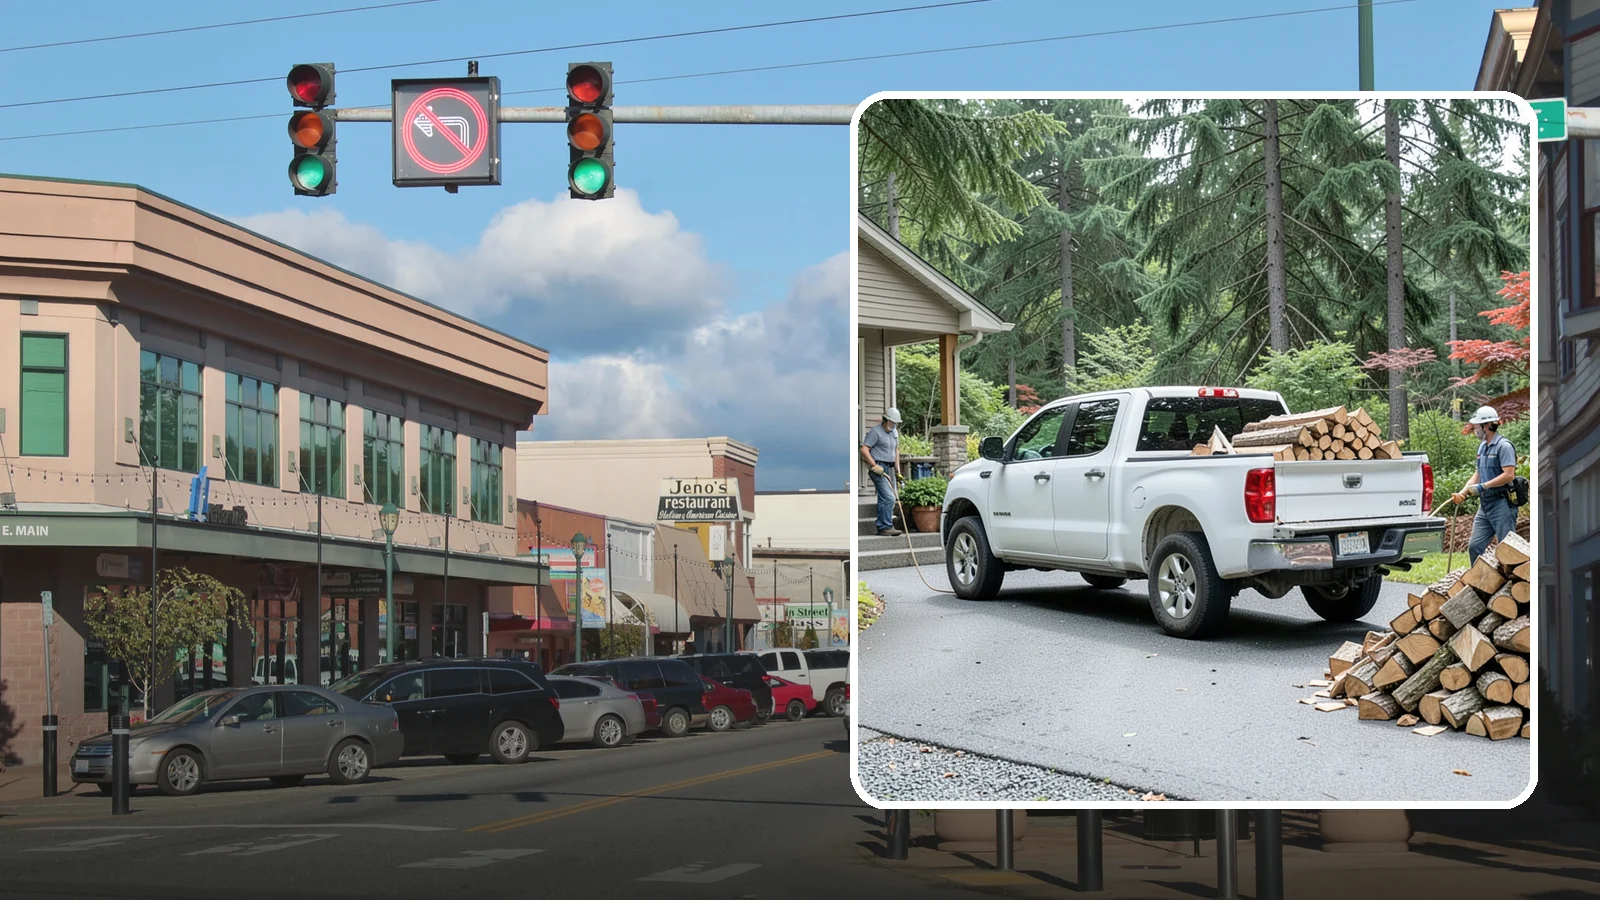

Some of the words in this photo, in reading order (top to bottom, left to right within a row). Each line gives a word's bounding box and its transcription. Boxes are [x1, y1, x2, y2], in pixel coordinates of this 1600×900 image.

[670, 480, 727, 494] Jeno's
[665, 496, 731, 509] restaurant
[658, 510, 681, 519] Italian
[686, 510, 715, 519] American
[715, 510, 737, 519] Cuisine
[2, 525, 13, 536] E.
[15, 525, 49, 536] MAIN
[786, 607, 795, 617] in
[797, 607, 828, 617] Street
[791, 619, 823, 627] lass
